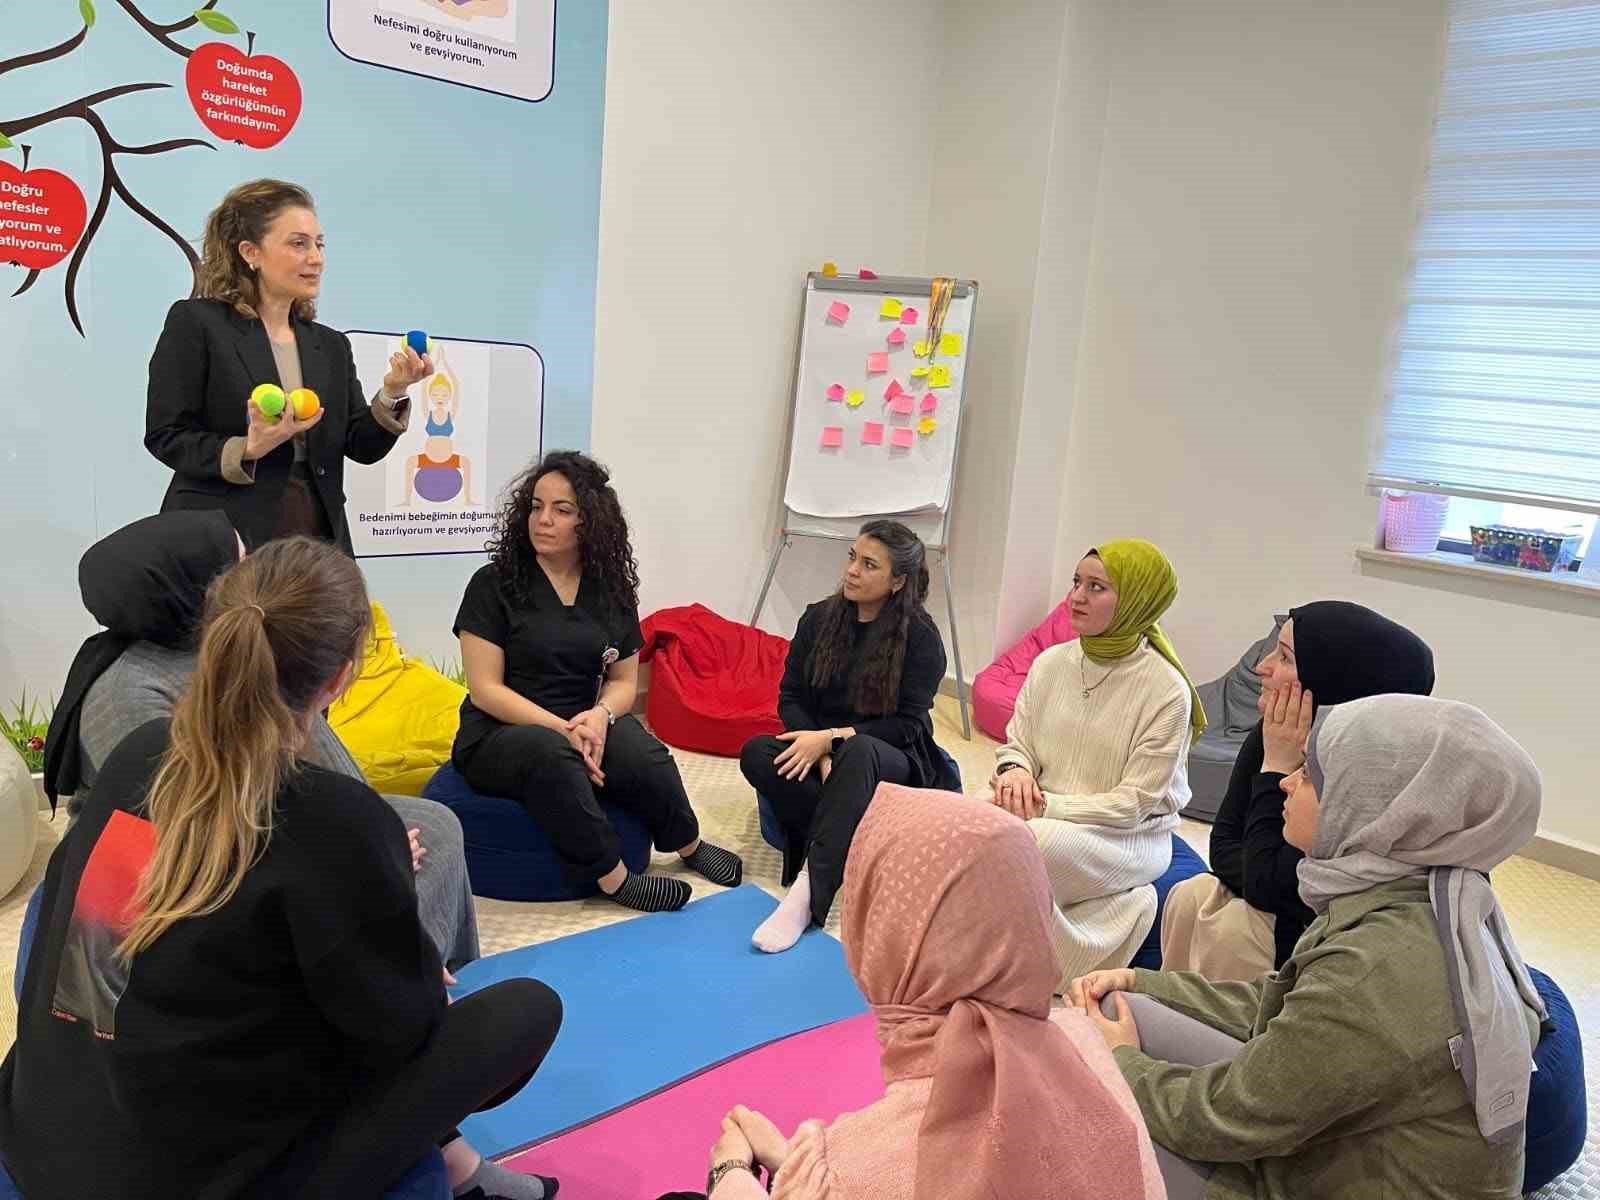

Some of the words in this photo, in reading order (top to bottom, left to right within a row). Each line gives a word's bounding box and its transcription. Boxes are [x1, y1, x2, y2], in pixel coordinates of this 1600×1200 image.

[373, 14, 420, 34] Nefesimi
[422, 26, 453, 42] doğru
[455, 34, 518, 60] kullanıyorum
[409, 42, 423, 51] ve
[424, 45, 485, 67] gevşiyorum.
[216, 59, 273, 81] Doğumda
[222, 77, 268, 97] hareket
[201, 89, 286, 117] özgürlüğümün
[206, 107, 280, 132] farkındayım.
[1, 180, 44, 197] Doğru
[45, 224, 62, 235] ve
[0, 234, 68, 253] atlıyorum.
[359, 512, 406, 522] Bedenimi
[408, 511, 458, 522] bebeğimin
[372, 526, 433, 537] hazırlıyorum
[435, 526, 446, 535] ve
